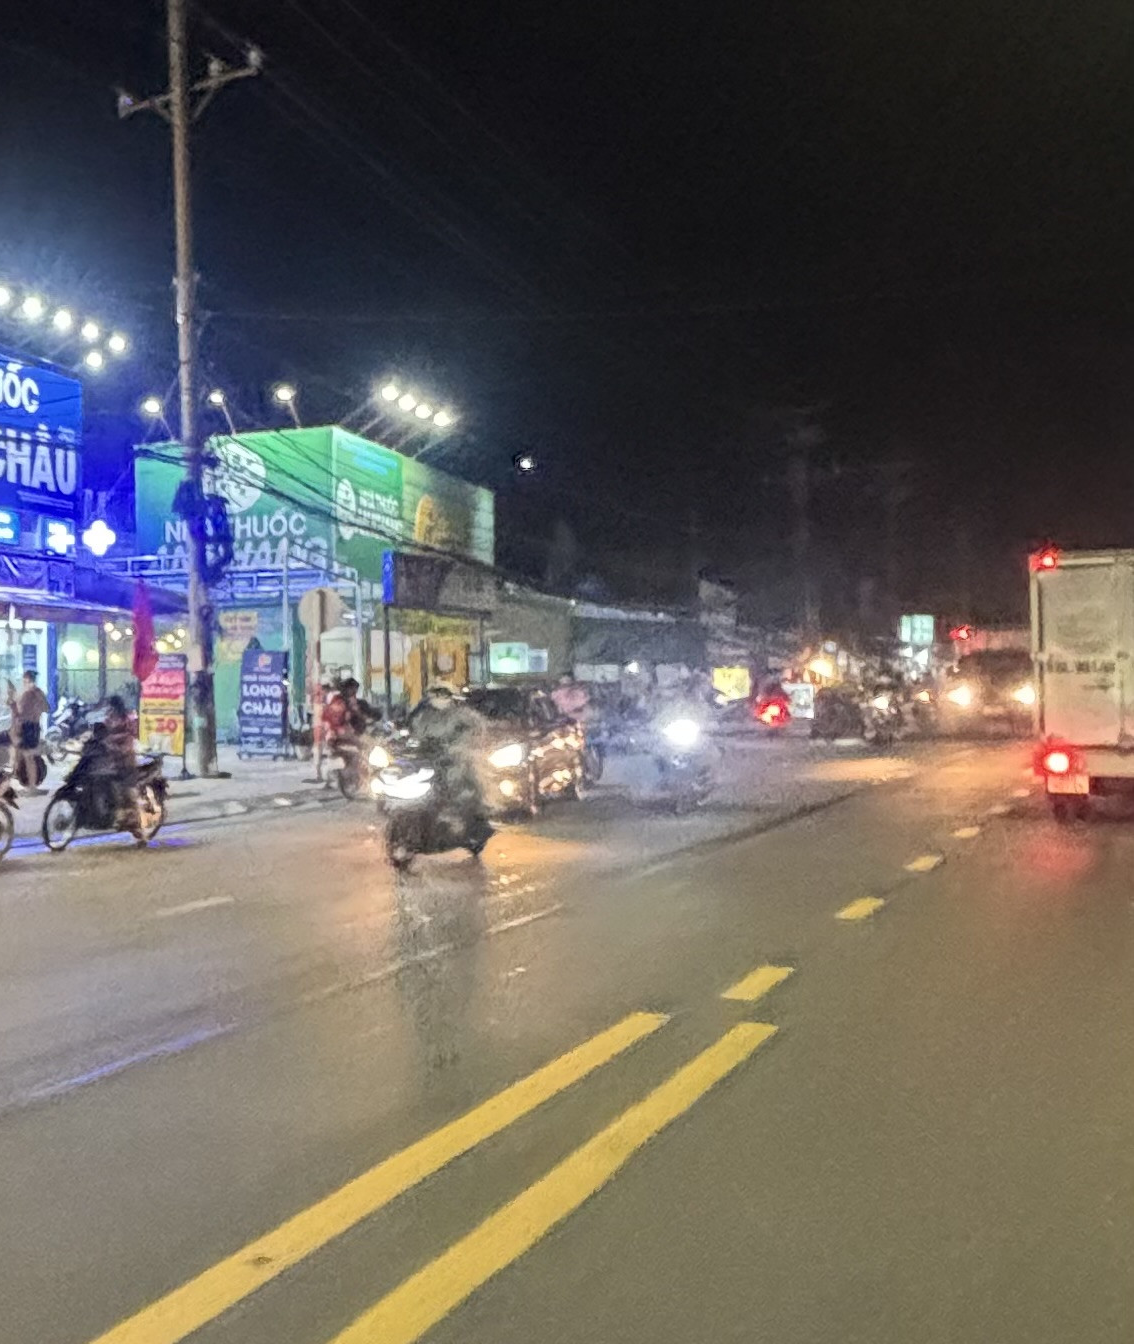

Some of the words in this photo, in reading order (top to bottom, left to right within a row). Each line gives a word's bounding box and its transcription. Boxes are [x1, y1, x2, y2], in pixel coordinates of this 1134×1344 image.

[227, 507, 307, 540] HUỐC
[242, 683, 282, 697] LONG
[241, 698, 283, 716] CHÂU
